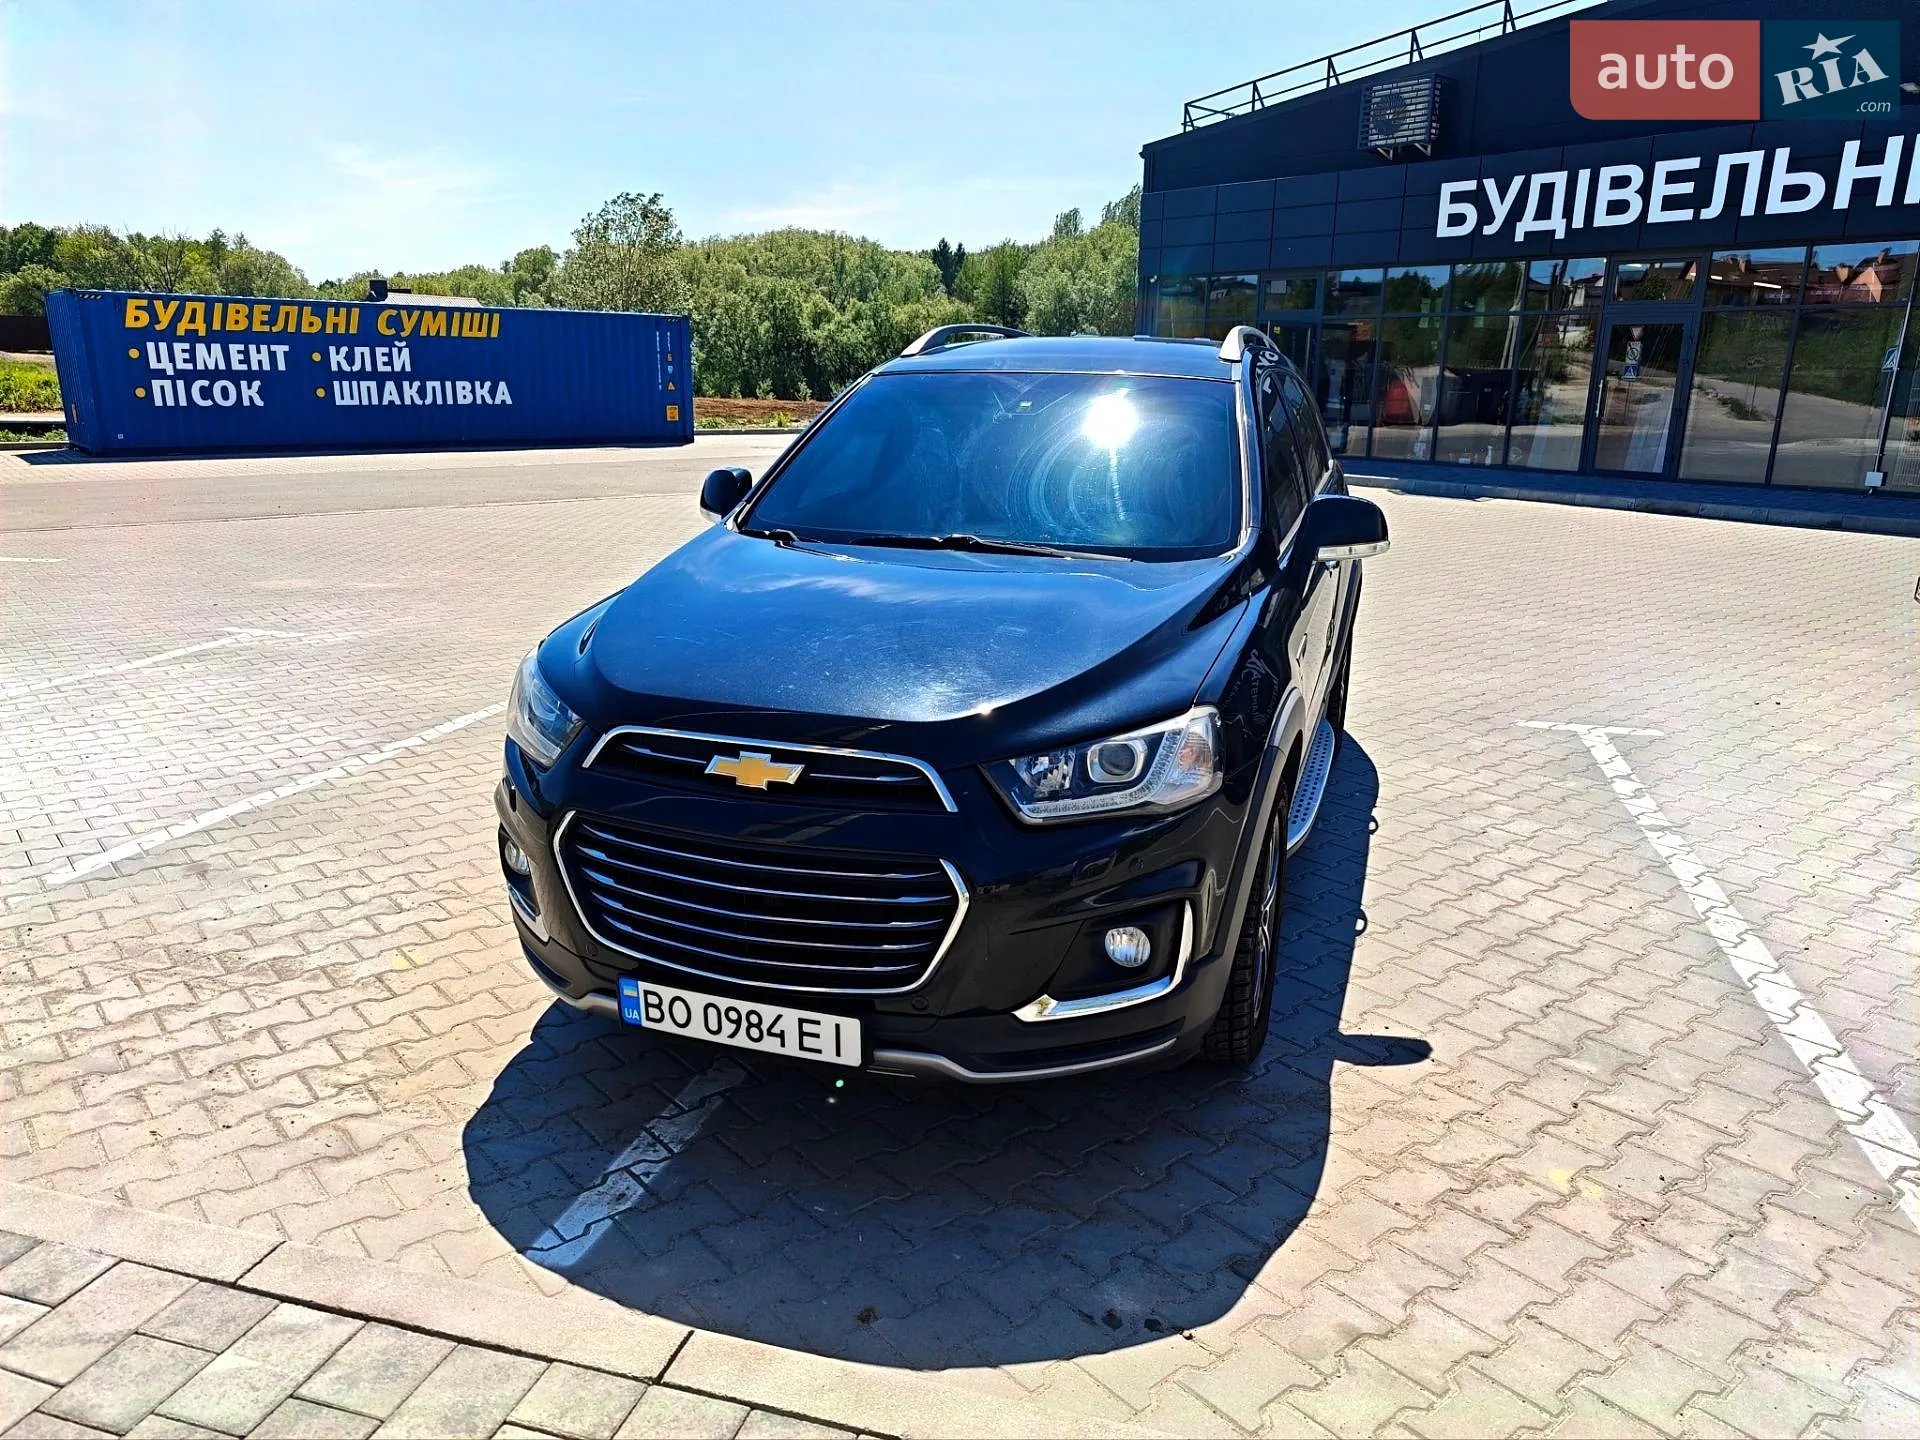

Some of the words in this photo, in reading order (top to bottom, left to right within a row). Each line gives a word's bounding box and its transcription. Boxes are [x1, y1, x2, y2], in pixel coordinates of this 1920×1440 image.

[125, 299, 359, 336] БУДІВЕЛЬНІ
[377, 309, 500, 338] СУМІШІ
[146, 341, 289, 376] ЦЕМЕНТ
[328, 341, 411, 372] КЛЕЙ
[152, 379, 264, 407] ПІСОК
[333, 380, 513, 405] ШПАКЛІВКА
[625, 1008, 640, 1020] UA
[643, 990, 692, 1029] BO
[703, 1002, 786, 1048] 0984
